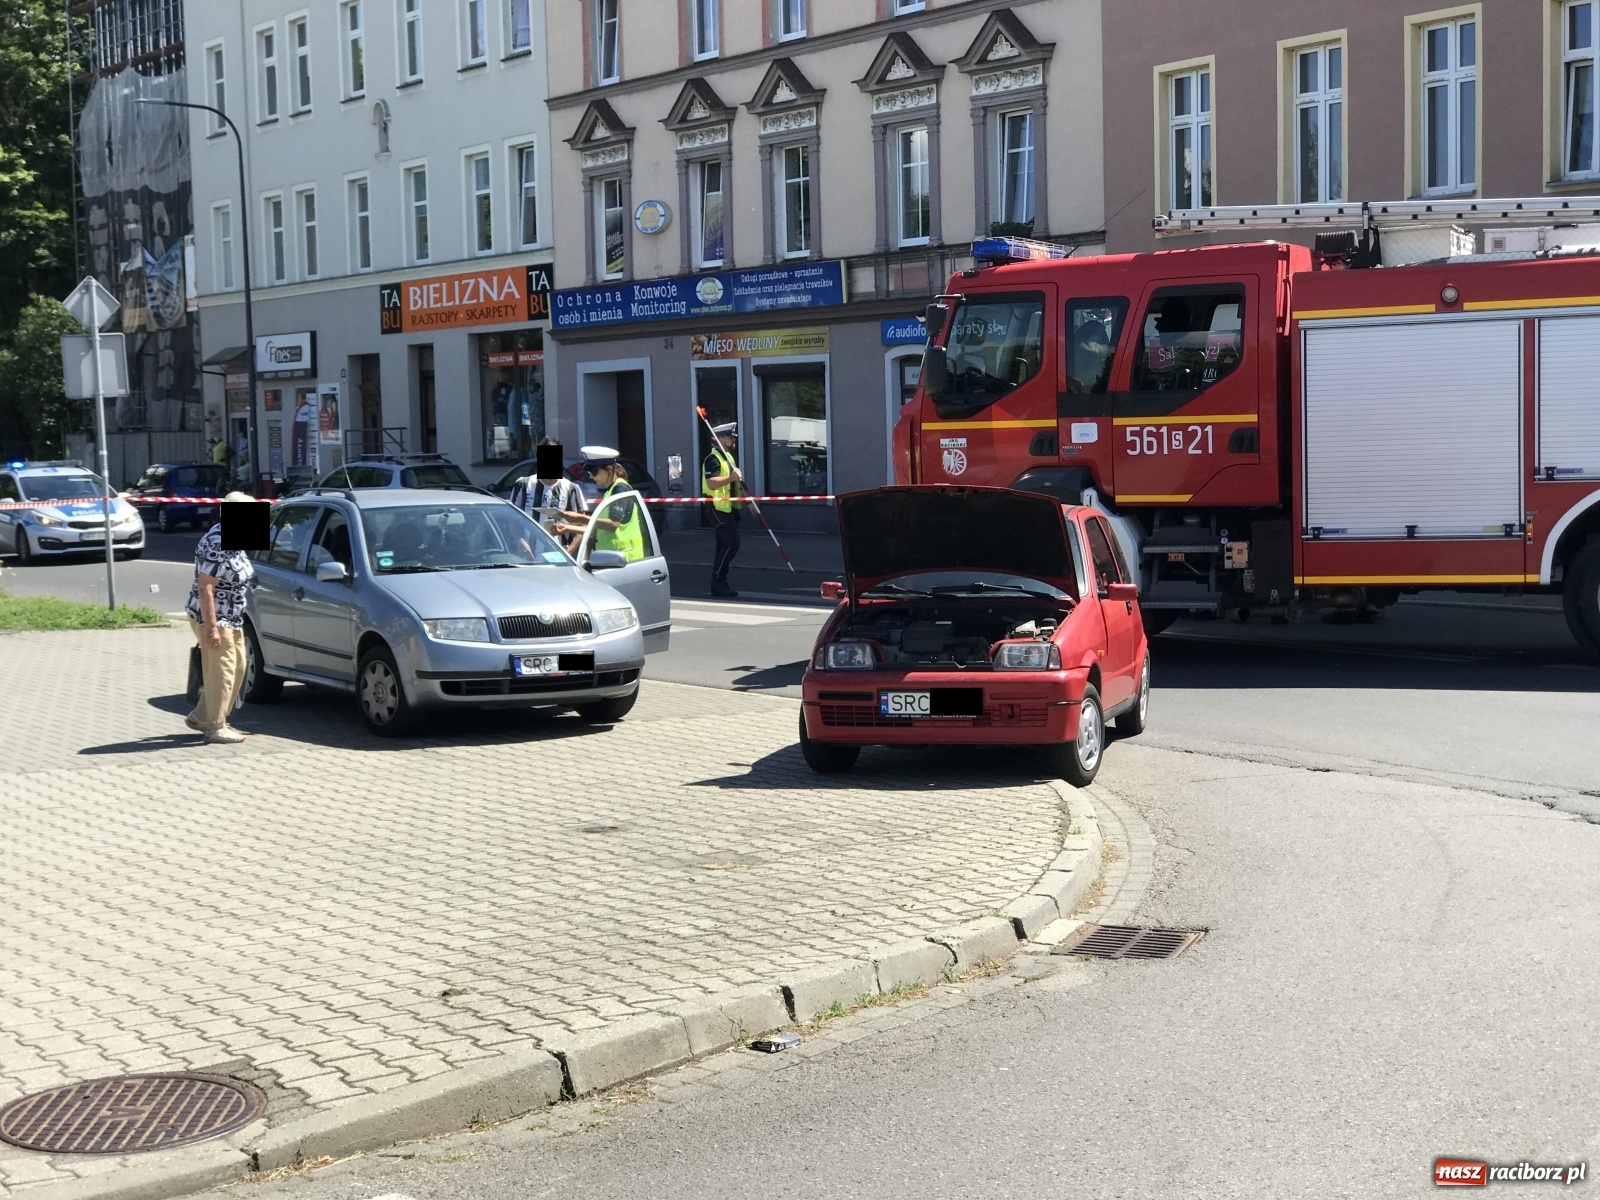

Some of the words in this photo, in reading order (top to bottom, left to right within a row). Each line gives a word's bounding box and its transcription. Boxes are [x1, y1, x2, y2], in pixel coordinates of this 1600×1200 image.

[528, 270, 551, 292] TA
[805, 280, 833, 290] trawników
[381, 290, 401, 308] TA
[408, 275, 521, 311] BIELIZNA
[557, 291, 622, 308] Ochrona
[633, 281, 678, 300] Konwoje
[382, 310, 400, 329] BU
[411, 310, 459, 326] RAJSTOPY
[466, 304, 518, 321] SKARPETY
[558, 310, 581, 325] osób
[582, 309, 588, 322] i
[589, 307, 624, 322] mienia
[631, 299, 687, 317] Monitoring
[895, 323, 927, 338] audiofo
[948, 321, 985, 338] paraty
[663, 338, 674, 349] 34
[703, 339, 733, 355] MIĘSO
[736, 335, 781, 354] WĘDLINY
[781, 335, 803, 347] swojskie
[803, 336, 825, 347] wyroby
[488, 355, 514, 363] BIELIZNA
[523, 657, 552, 673] SRC
[891, 694, 929, 712] SRC
